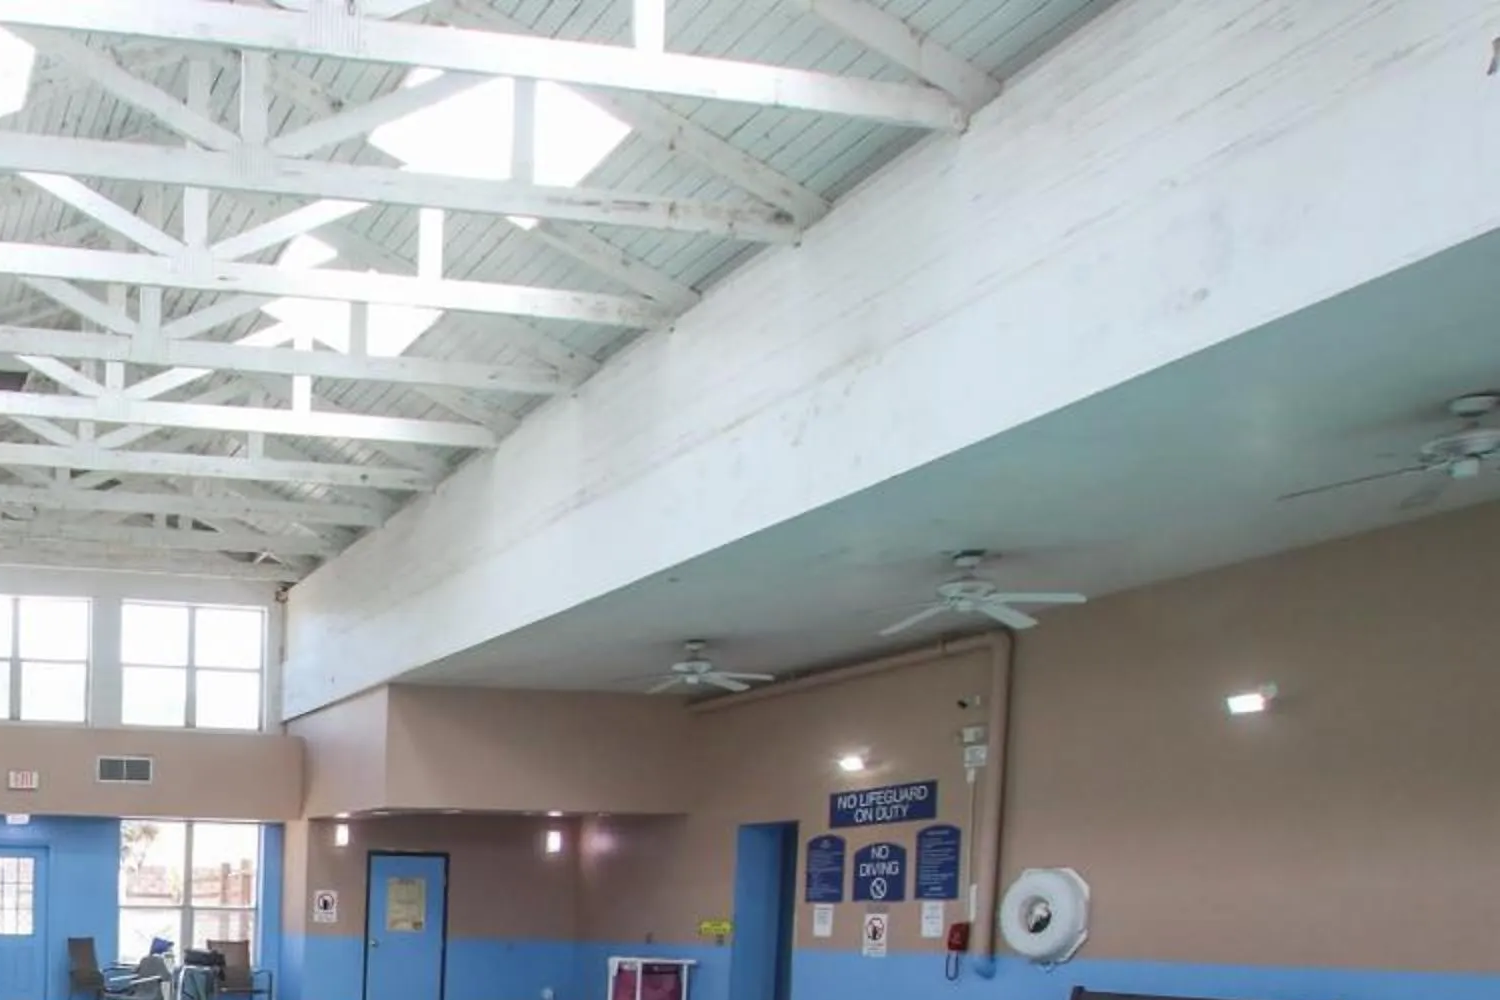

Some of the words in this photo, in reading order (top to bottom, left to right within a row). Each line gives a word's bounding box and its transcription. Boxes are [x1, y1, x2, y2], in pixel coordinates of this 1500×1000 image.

[837, 795, 857, 809] NO
[860, 785, 929, 806] LIFEGUARD
[854, 808, 873, 823] ON
[875, 803, 909, 820] DUTY
[871, 845, 889, 860] NO
[859, 861, 899, 877] DIVING
